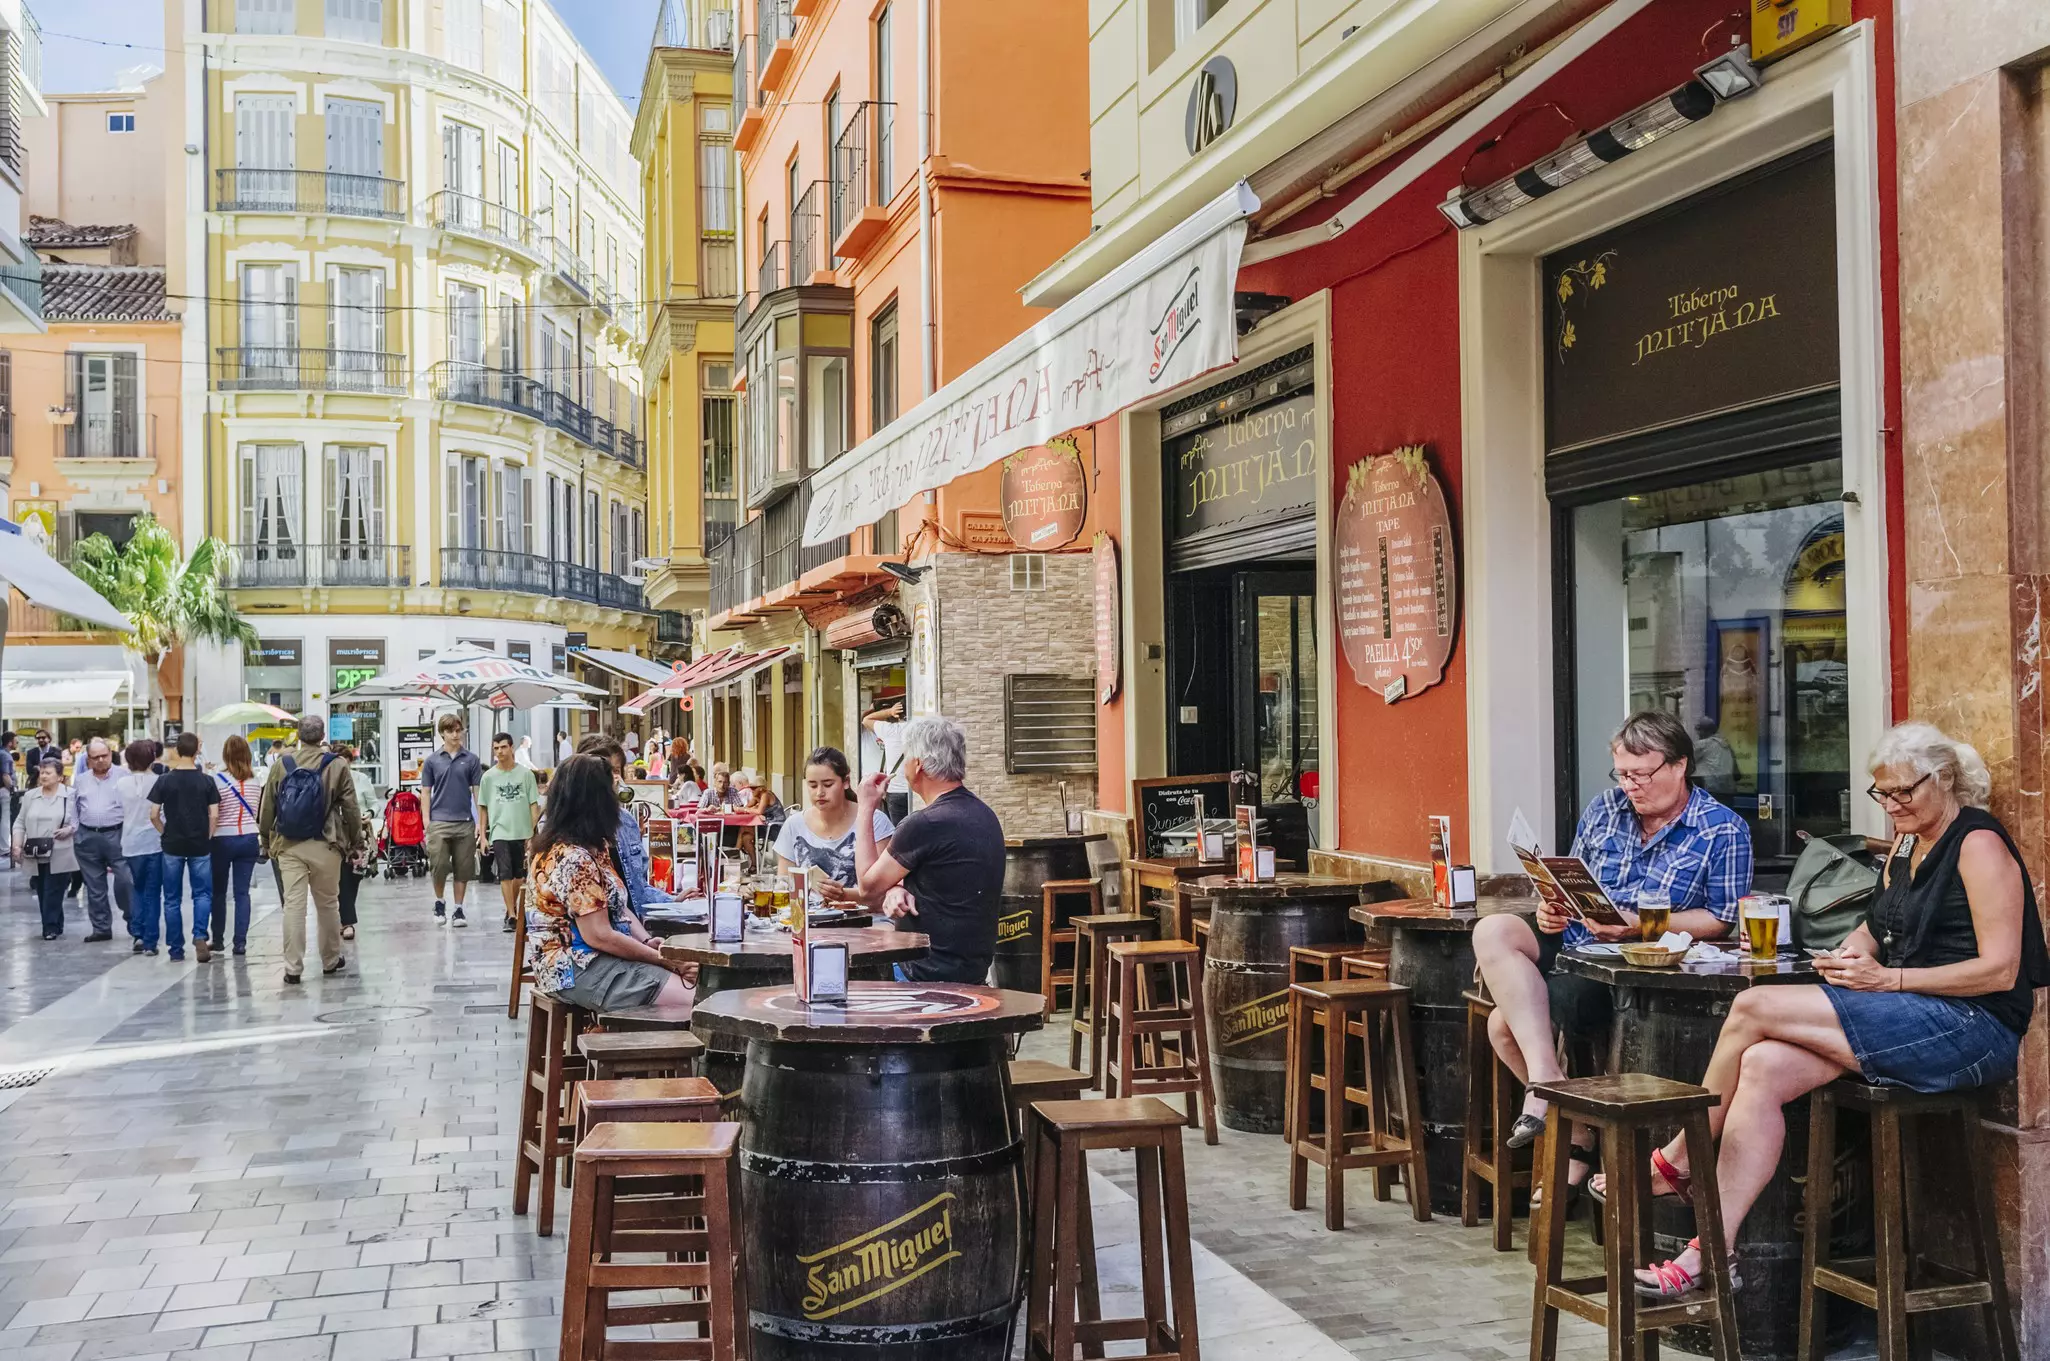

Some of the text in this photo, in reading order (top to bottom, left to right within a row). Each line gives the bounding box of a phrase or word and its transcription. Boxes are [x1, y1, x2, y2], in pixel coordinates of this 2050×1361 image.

[1667, 284, 1738, 320] Taberna
[1149, 281, 1199, 376] San Miguel
[1631, 293, 1781, 366] MITJANA
[1221, 406, 1296, 451] Taberna
[1021, 479, 1063, 494] Taberna
[1186, 439, 1316, 518] MITJAN
[1372, 479, 1400, 494] Taberna
[1007, 492, 1080, 523] MITJANA
[1360, 491, 1416, 521] MITJANA
[1365, 643, 1400, 664] PAELLA
[998, 916, 1029, 937] Miguel
[1242, 1001, 1290, 1029] Migue
[802, 1208, 953, 1311] San Miguel
